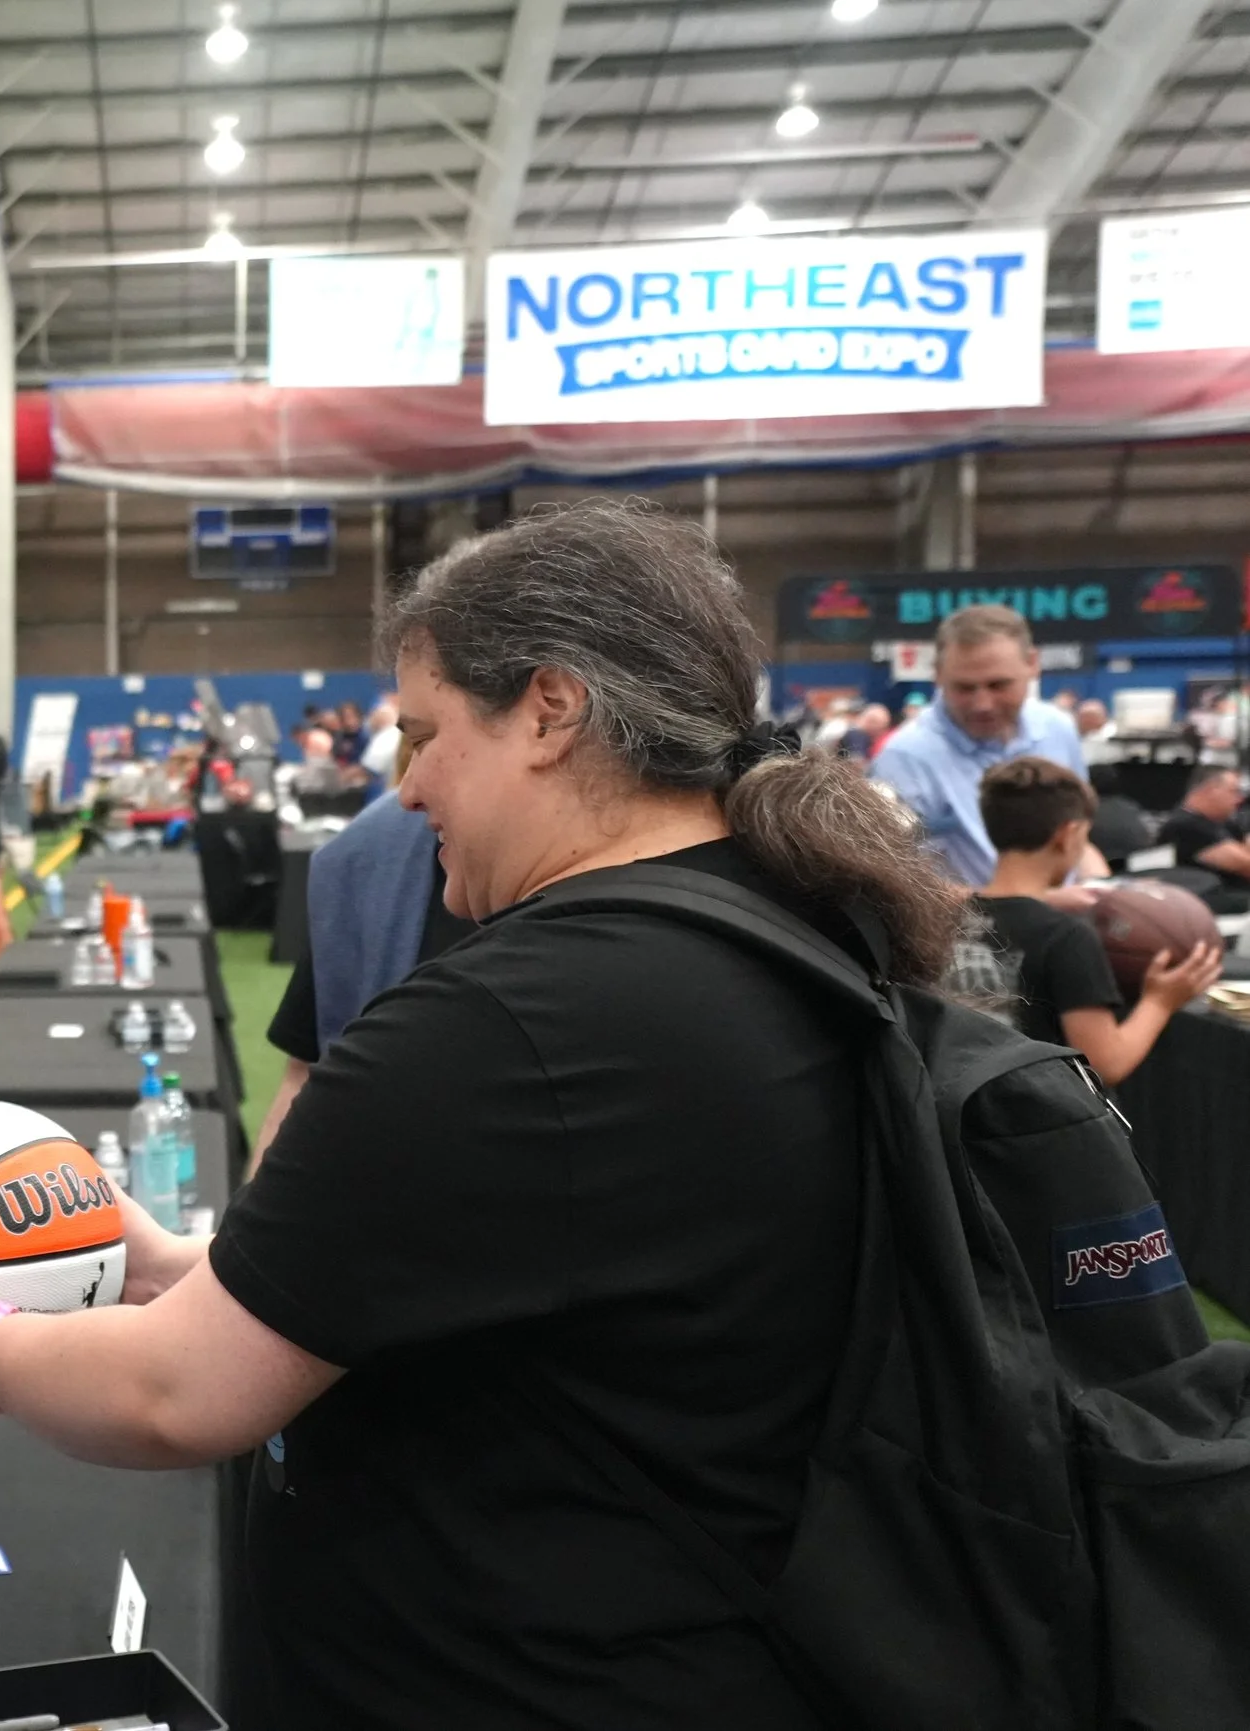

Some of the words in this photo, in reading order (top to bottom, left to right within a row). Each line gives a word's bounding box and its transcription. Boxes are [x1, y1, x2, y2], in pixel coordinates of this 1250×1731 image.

[507, 253, 1026, 341] NORTHEAST
[575, 332, 728, 387] SPORTS
[728, 330, 839, 373] CARD
[839, 330, 948, 374] EXPO
[1065, 1229, 1170, 1285] JANSPORT
